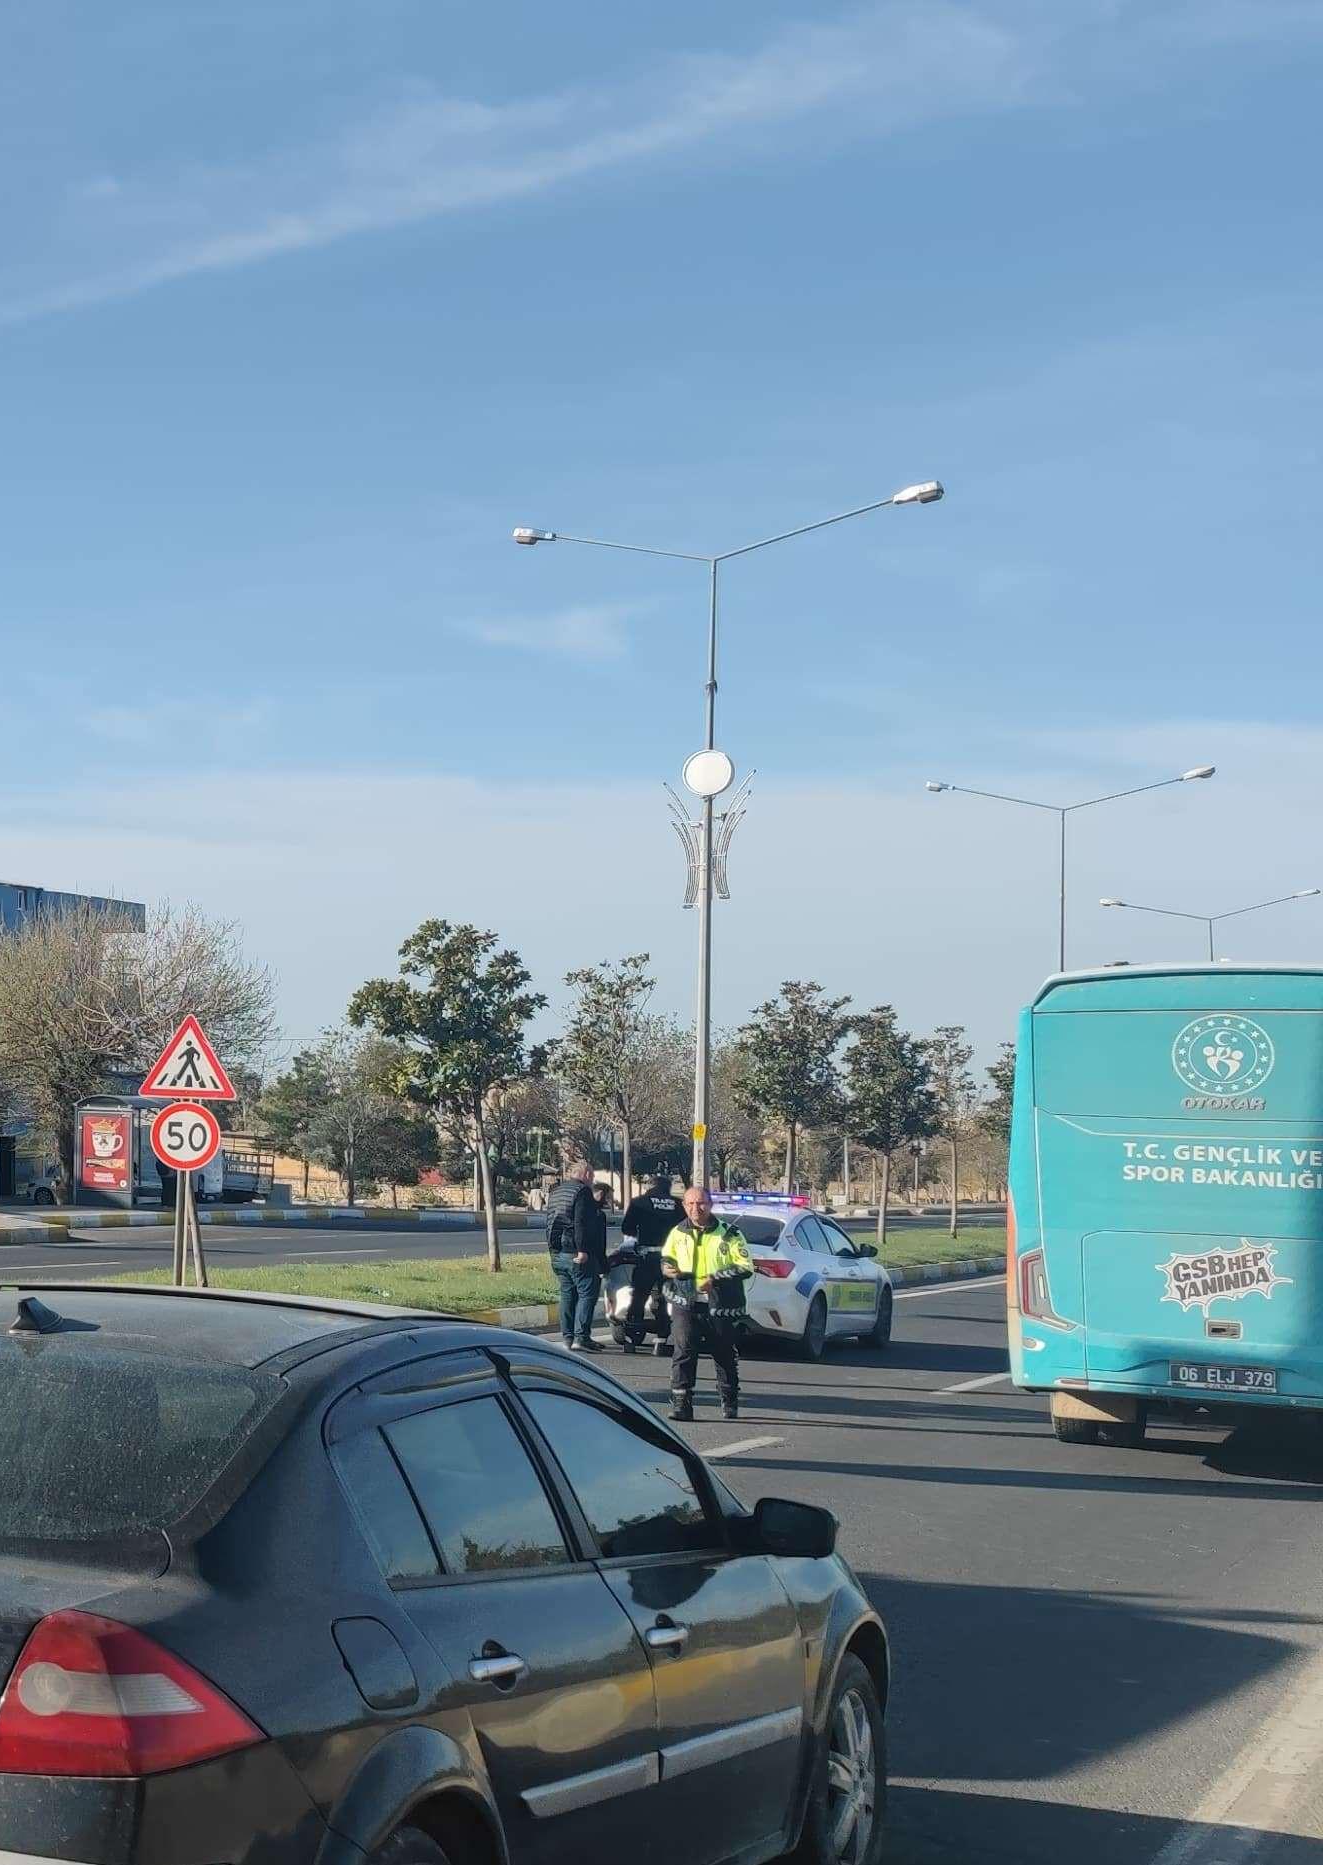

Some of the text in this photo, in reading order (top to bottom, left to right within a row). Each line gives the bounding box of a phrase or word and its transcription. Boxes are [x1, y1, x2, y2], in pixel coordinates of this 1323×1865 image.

[1181, 1097, 1267, 1112] OTOKAR
[167, 1121, 207, 1152] 50
[1123, 1142, 1323, 1168] T.C. GENÇLİK VE
[1123, 1164, 1323, 1190] SPOR BAKANLIĞI
[1173, 1251, 1265, 1283] GSB HEP
[1175, 1266, 1270, 1300] YANINDA
[1179, 1366, 1199, 1382] 06
[1207, 1368, 1235, 1384] ELJ
[1244, 1371, 1274, 1387] 379
